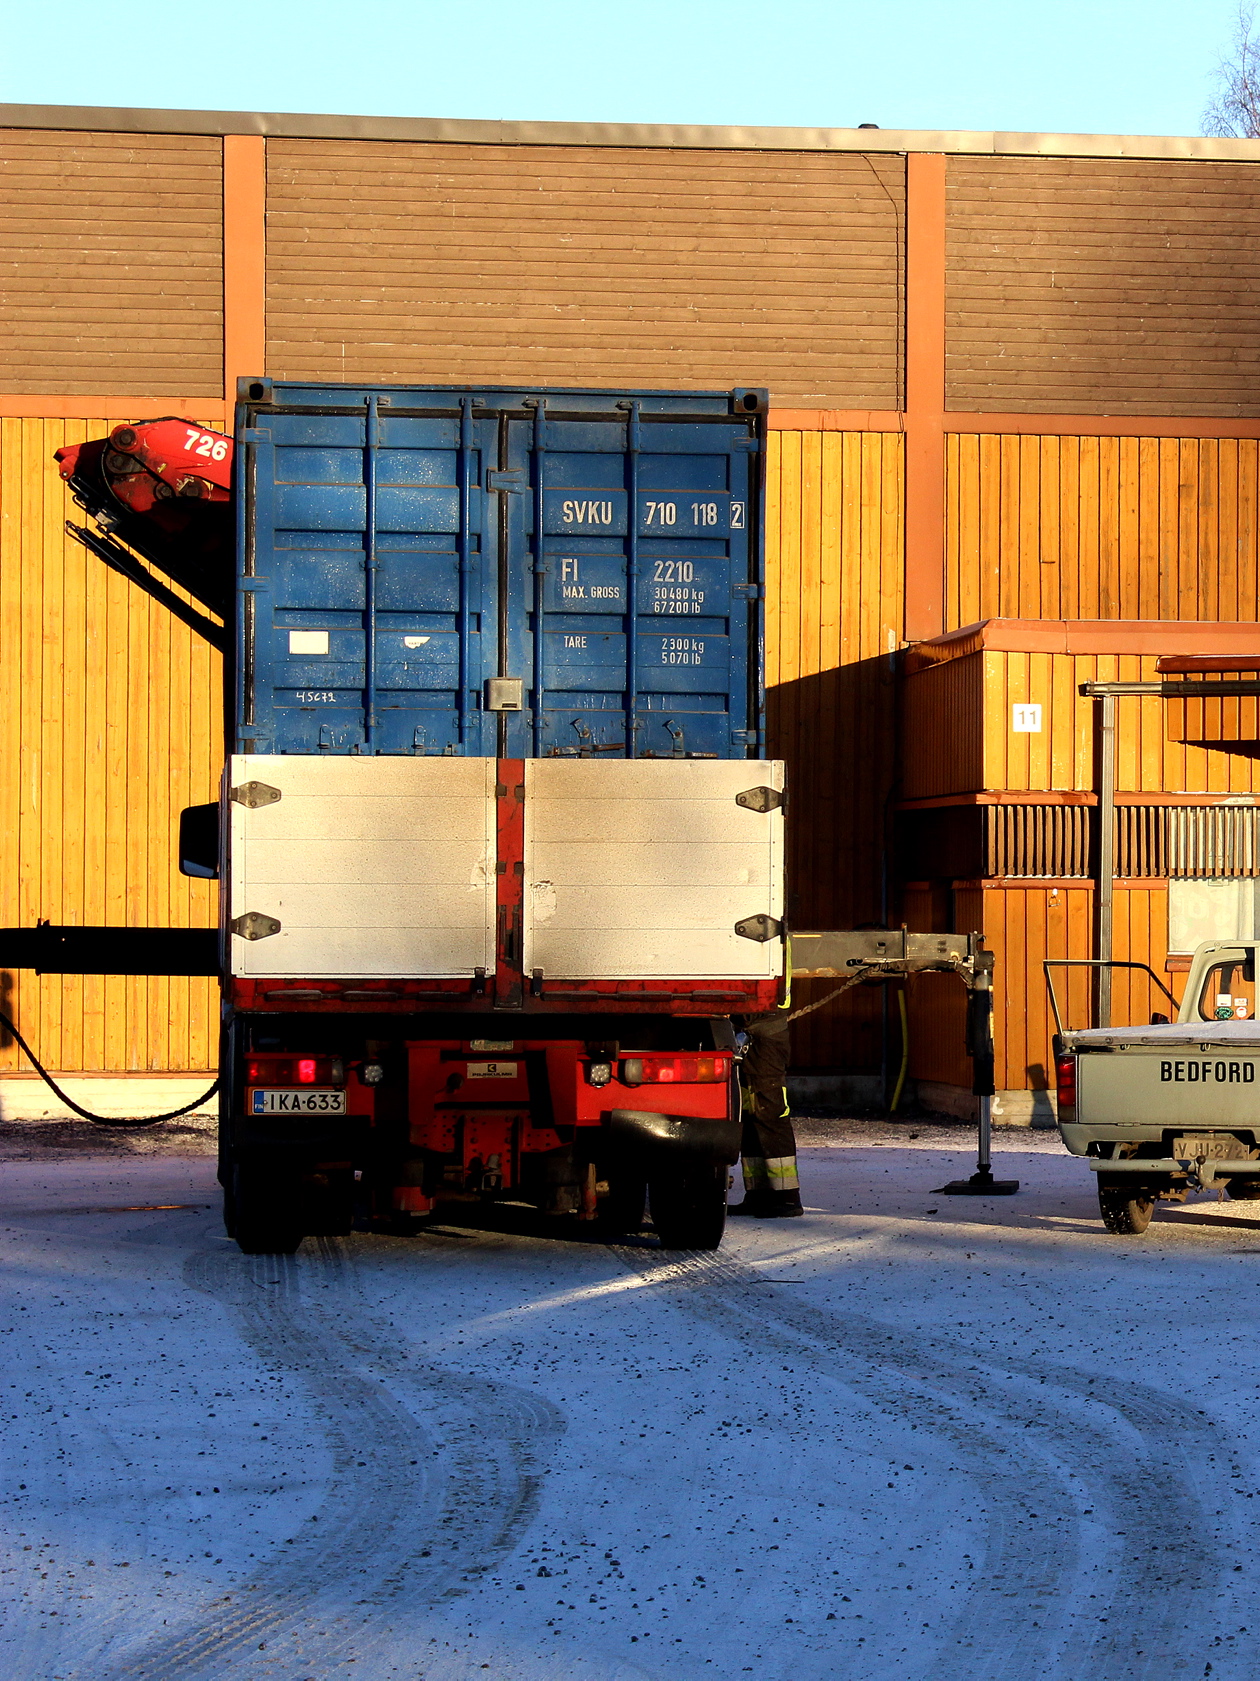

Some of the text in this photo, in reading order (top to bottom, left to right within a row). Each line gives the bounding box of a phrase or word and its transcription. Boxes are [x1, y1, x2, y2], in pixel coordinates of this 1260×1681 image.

[183, 429, 229, 462] 726
[562, 500, 743, 527] SVKU 710 118 2
[561, 558, 694, 583] FI 2210
[562, 586, 588, 599] MAX.
[590, 586, 620, 599] GROSS
[691, 588, 704, 603] kg
[691, 602, 701, 614] lb
[564, 636, 587, 648] TARE
[691, 638, 704, 654] kg
[691, 653, 701, 664] lb
[1018, 710, 1037, 725] 11
[1160, 1061, 1255, 1083] BEDFORD
[270, 1093, 341, 1111] IKA-633
